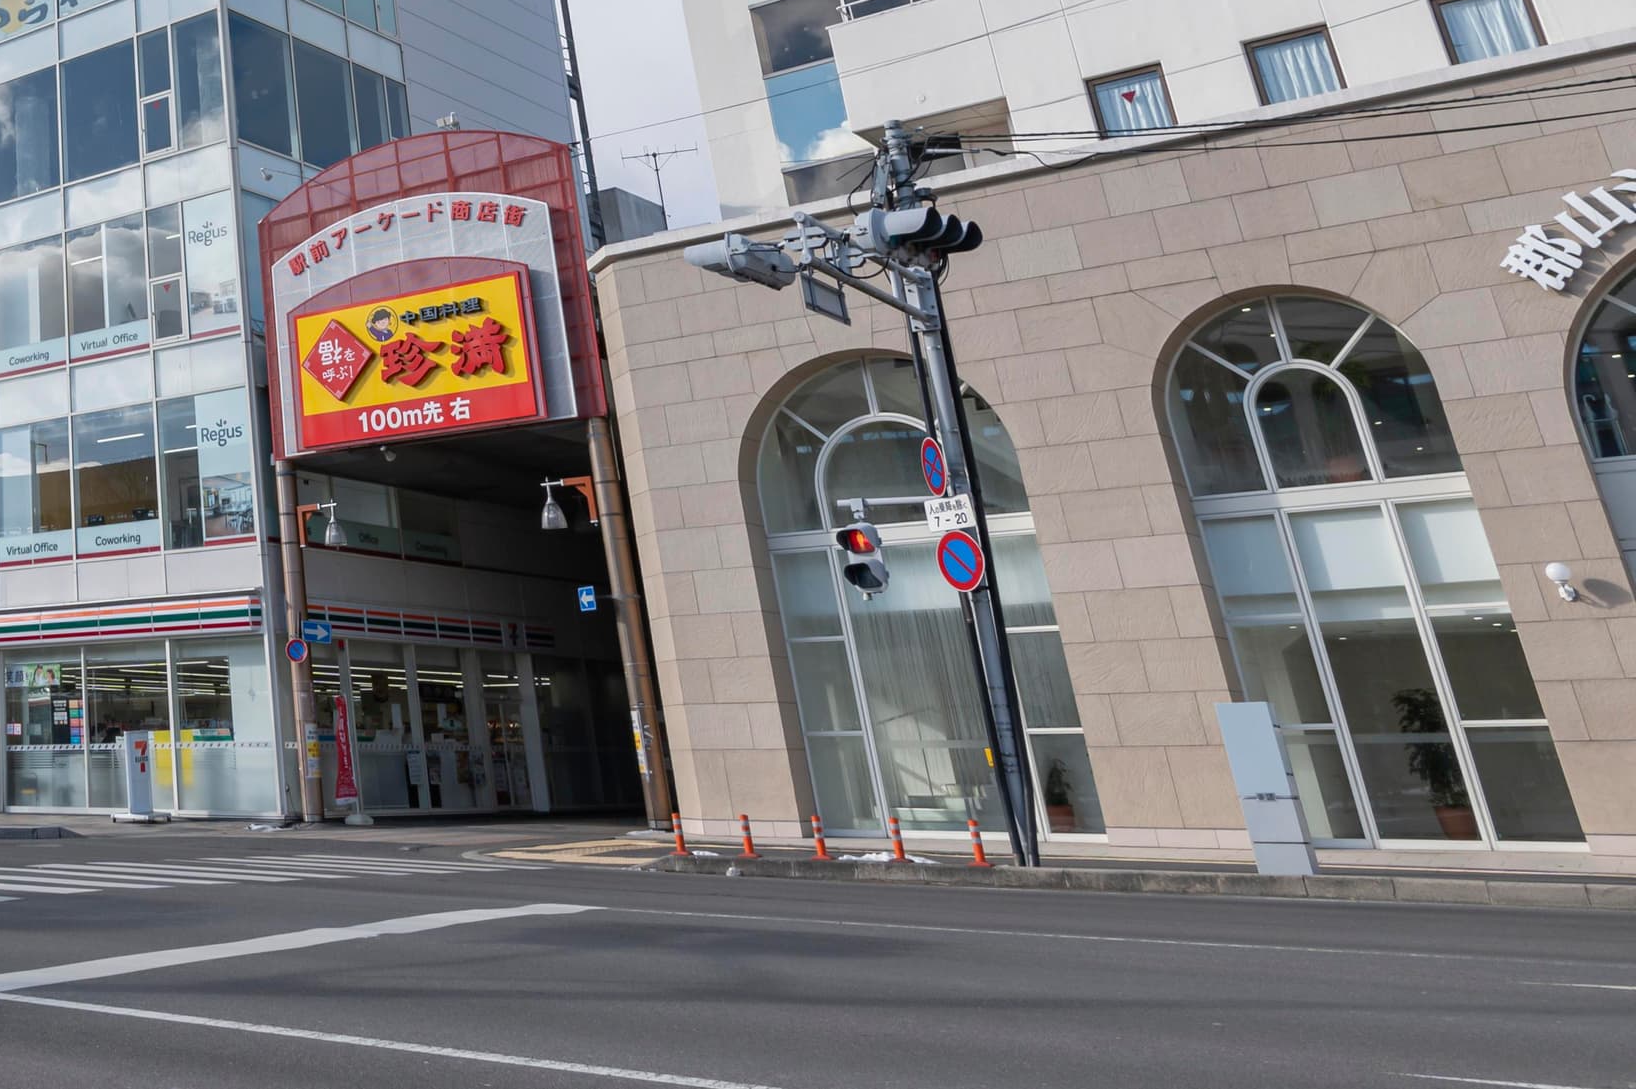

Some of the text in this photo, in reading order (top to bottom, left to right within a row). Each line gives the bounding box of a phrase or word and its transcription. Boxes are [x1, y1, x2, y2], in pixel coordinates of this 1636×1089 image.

[188, 223, 228, 246] Regus
[287, 200, 527, 277] 駅前アーケード商店街
[399, 296, 482, 325] 中国料理
[81, 332, 138, 351] Virtual Office
[9, 350, 50, 367] Coworking
[380, 317, 510, 387] 珍満
[358, 397, 471, 433] 100m先 右
[201, 425, 244, 447] Regus
[929, 499, 968, 514] 人の乗降を除く
[934, 516, 940, 528] 7
[954, 512, 968, 525] 20
[6, 540, 59, 556] Virtual Office
[95, 532, 141, 547] Coworking
